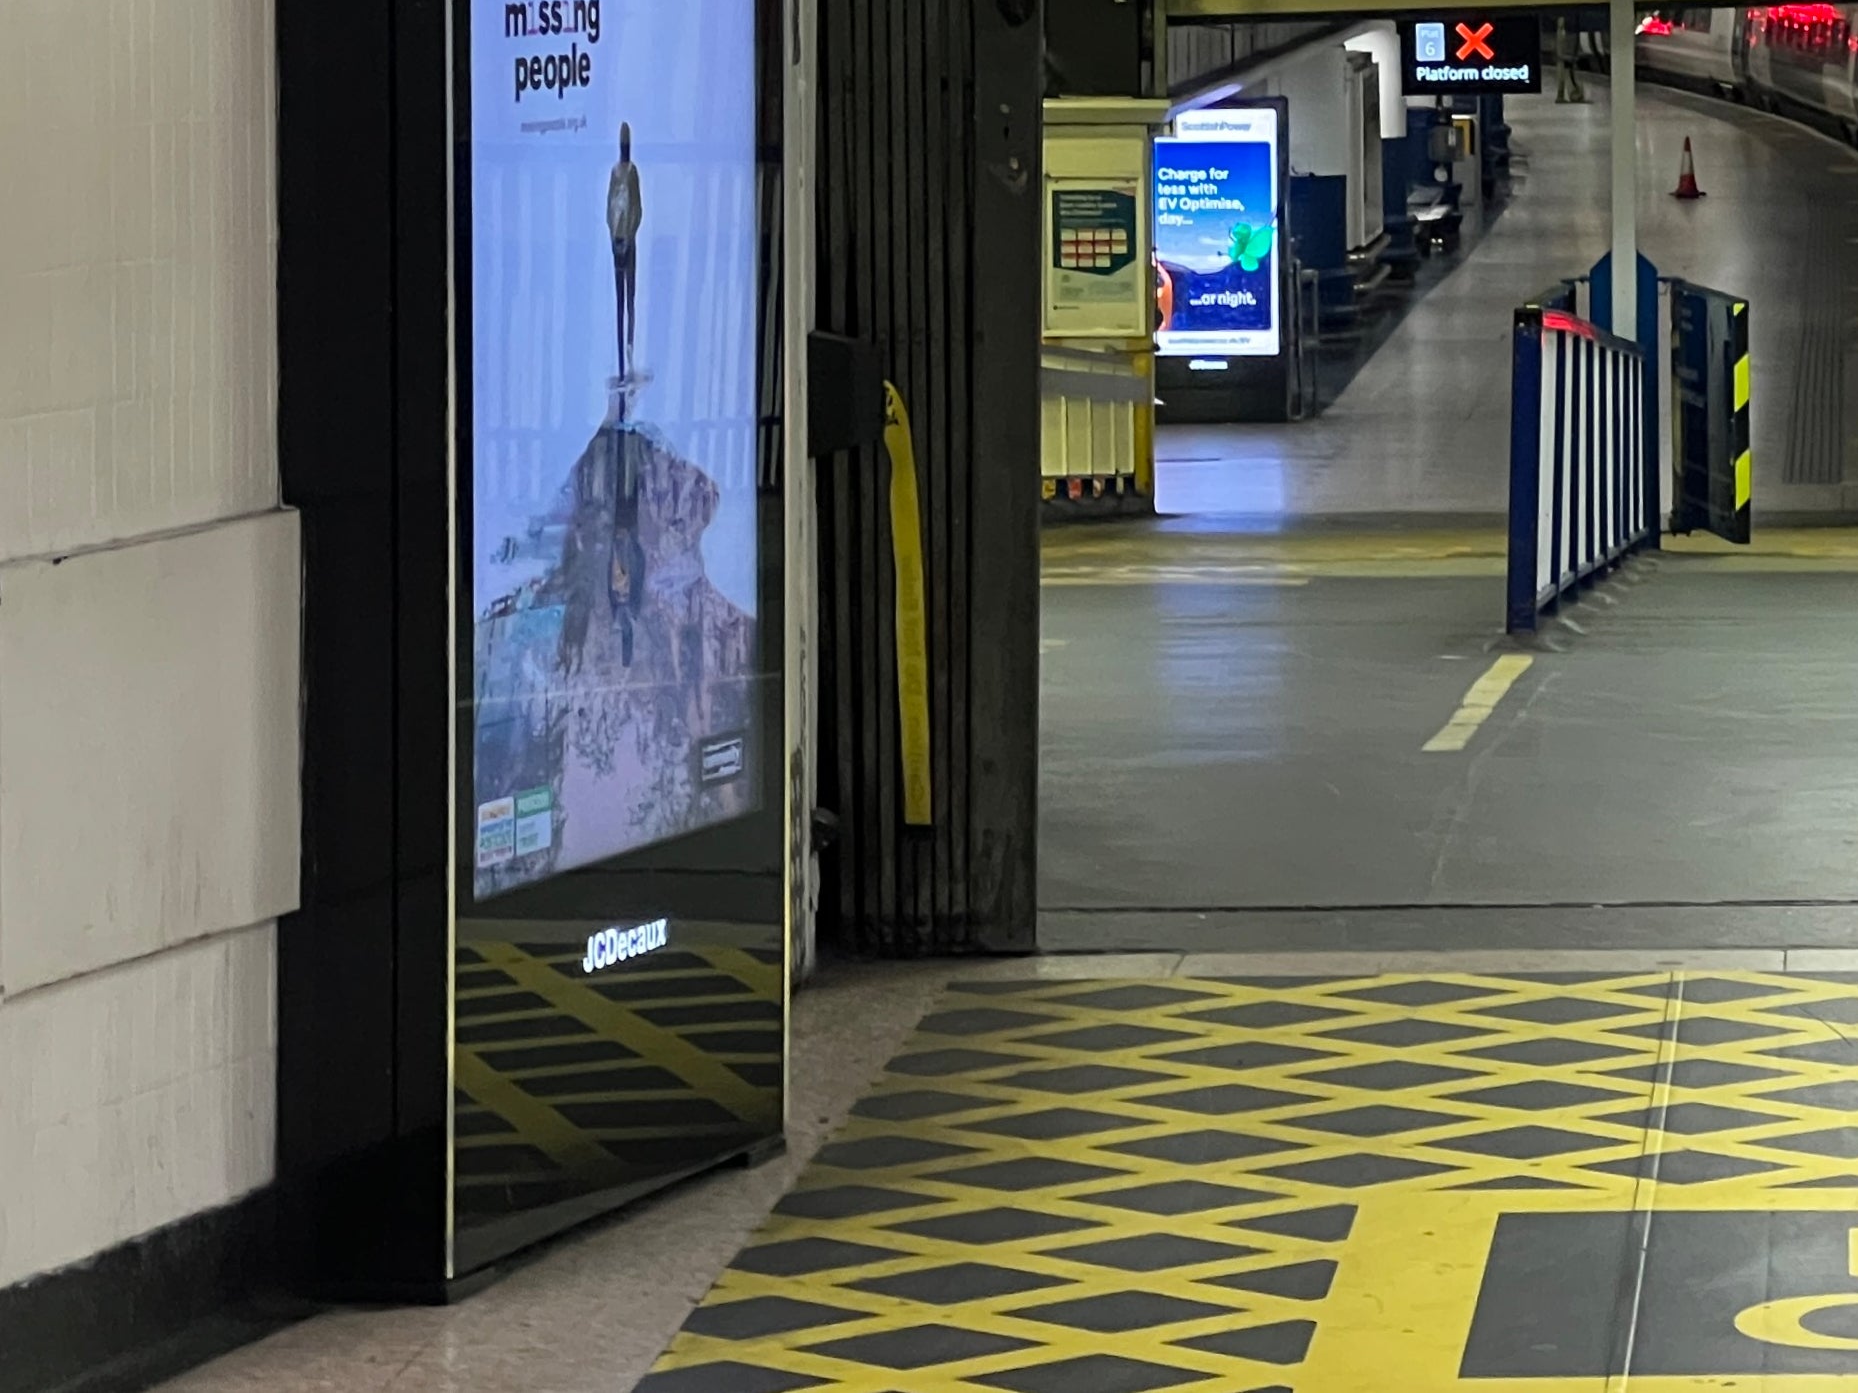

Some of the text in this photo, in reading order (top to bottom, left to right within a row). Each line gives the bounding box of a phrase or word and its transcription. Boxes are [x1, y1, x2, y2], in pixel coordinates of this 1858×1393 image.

[514, 42, 591, 103] people
[1416, 64, 1530, 81] Platform closed
[1158, 167, 1229, 183] Charge for
[1188, 183, 1218, 196] with
[1158, 197, 1178, 211] EV
[582, 918, 667, 974] JCDecaux
